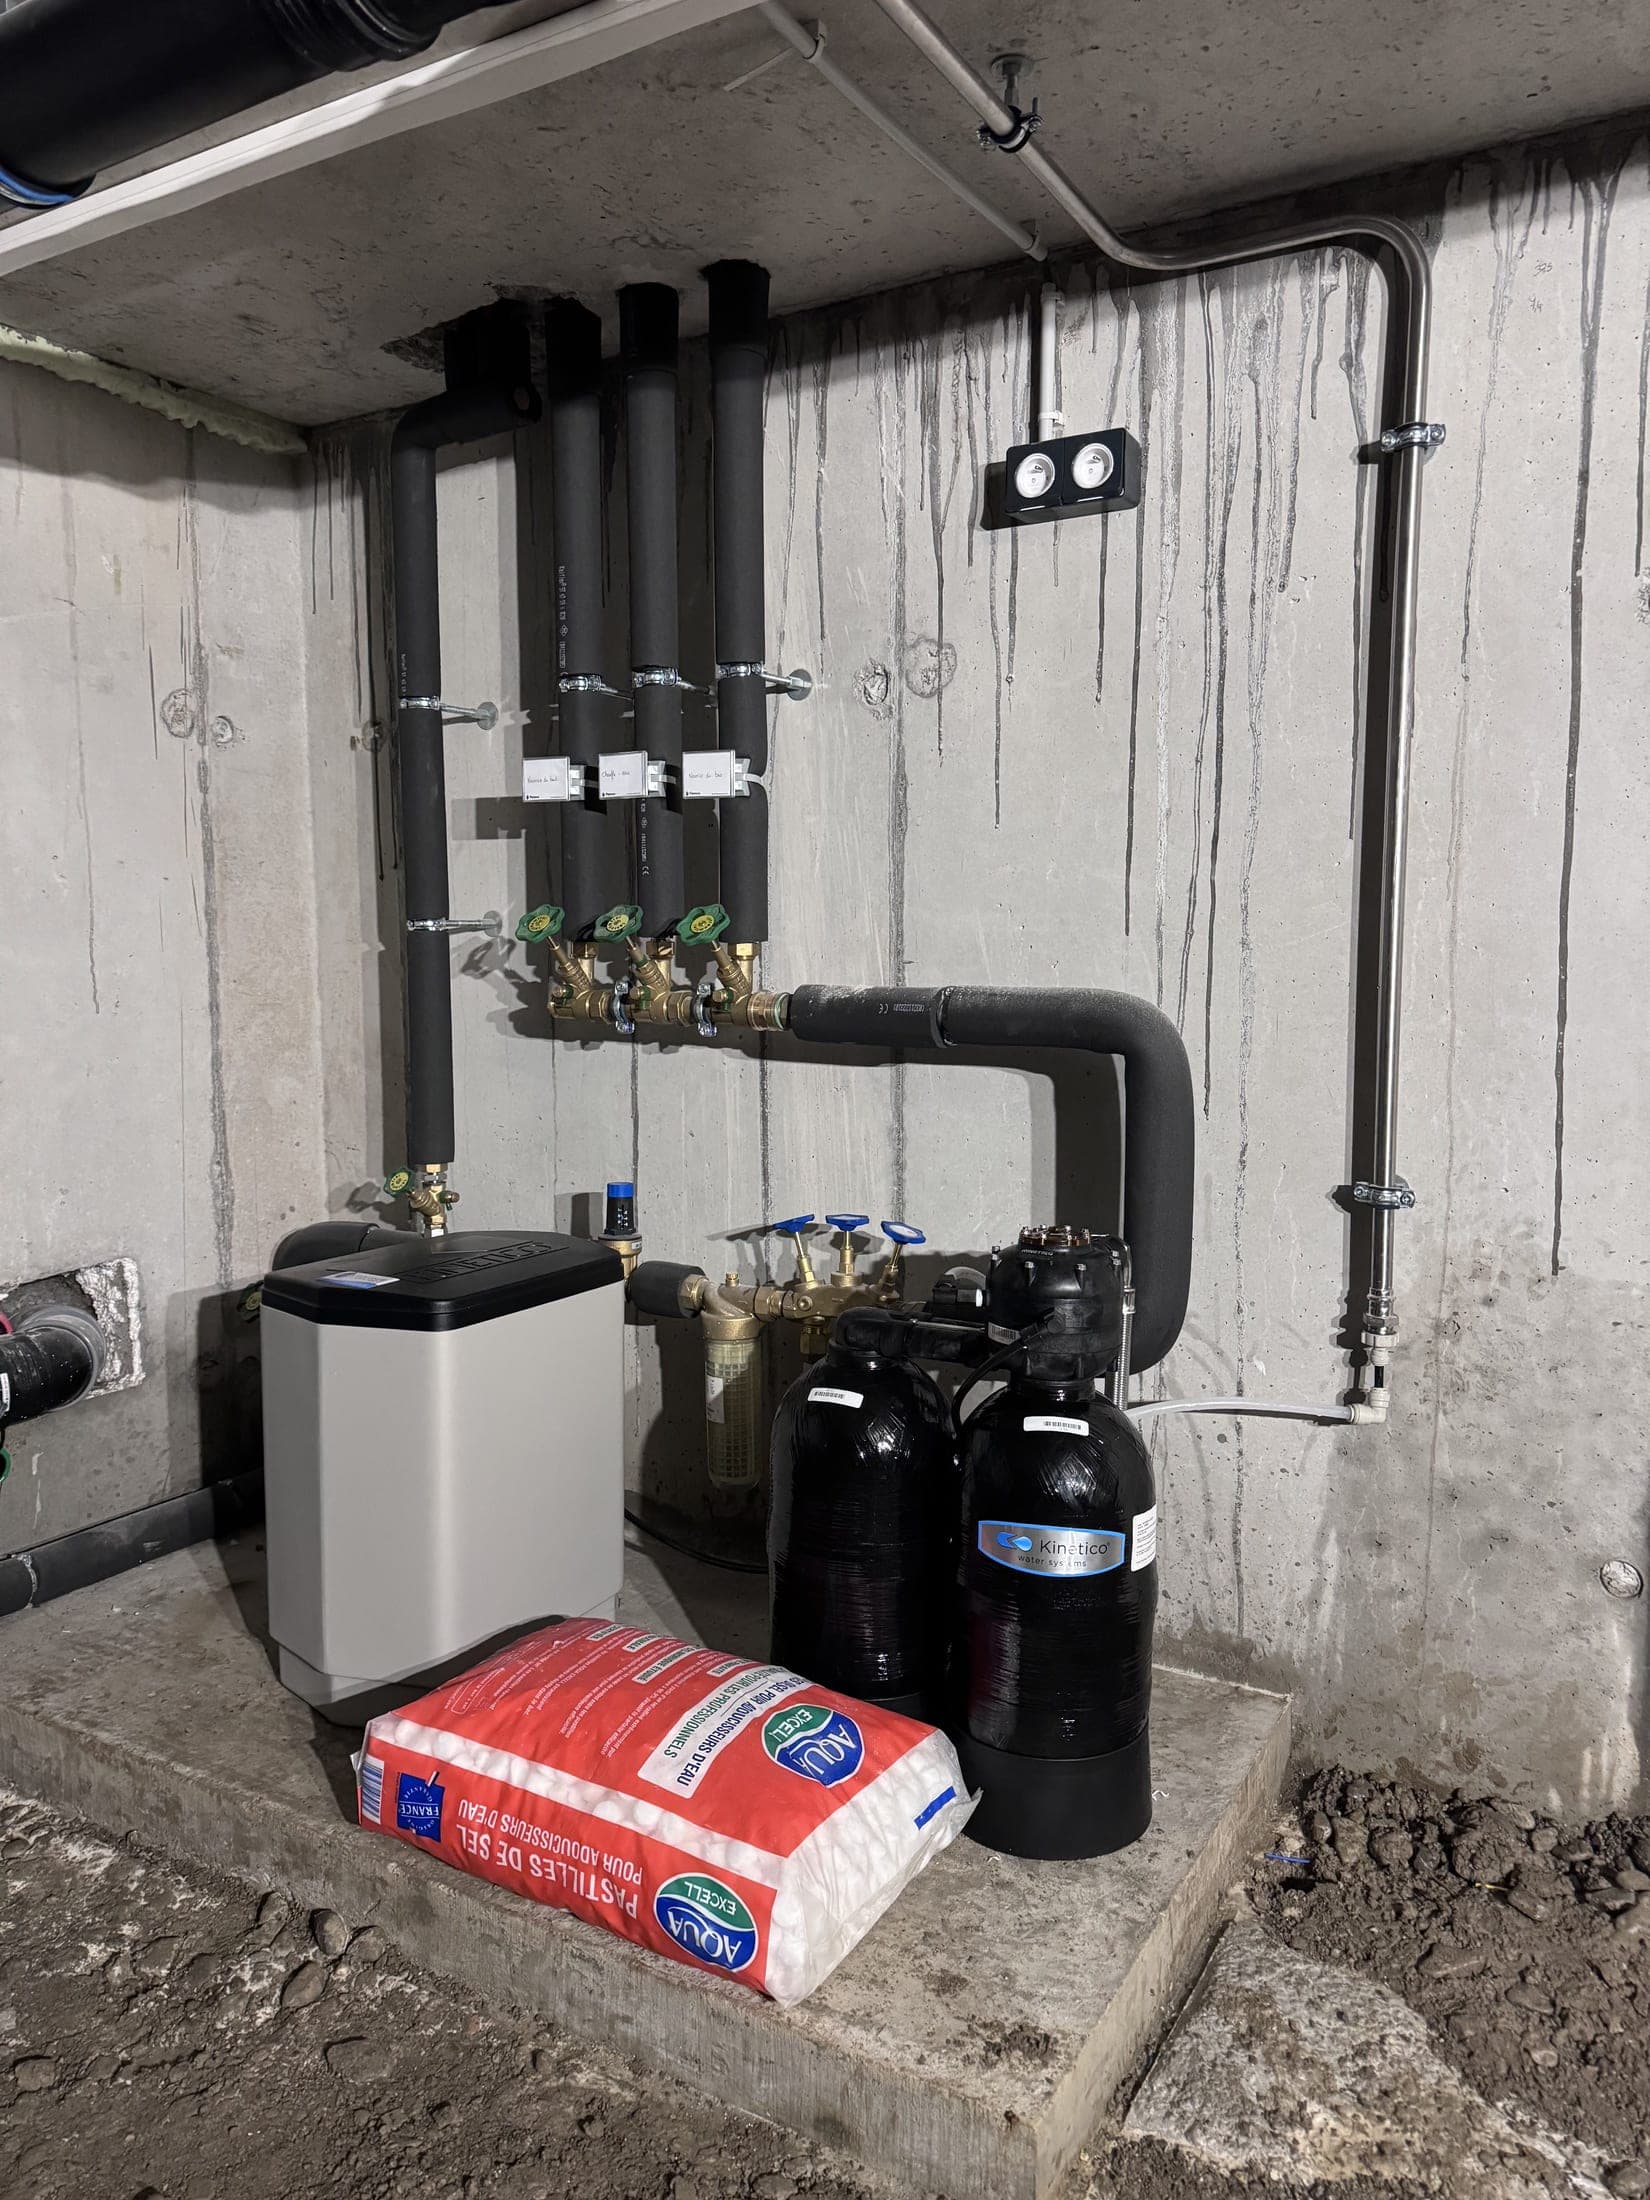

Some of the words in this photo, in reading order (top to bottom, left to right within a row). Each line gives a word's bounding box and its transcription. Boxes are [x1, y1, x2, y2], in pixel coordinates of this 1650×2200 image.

[1018, 1555, 1045, 1566] water
[750, 1689, 776, 1705] POUR
[663, 1692, 731, 1759] PROFESSIONNELS
[697, 1702, 757, 1752] ADOUCISSEURS
[676, 1750, 706, 1787] D'EAU
[790, 1723, 858, 1778] AQUA
[398, 1803, 439, 1816] FRANCE
[456, 1797, 499, 1828] D'EAU
[455, 1824, 492, 1859] SEL
[493, 1839, 526, 1871] DE
[498, 1812, 601, 1867] ADOUCISSEURS
[529, 1848, 640, 1919] PASTILLES
[600, 1852, 643, 1885] POUR
[681, 1879, 738, 1915] EXCELL
[666, 1902, 743, 1966] AQUA
